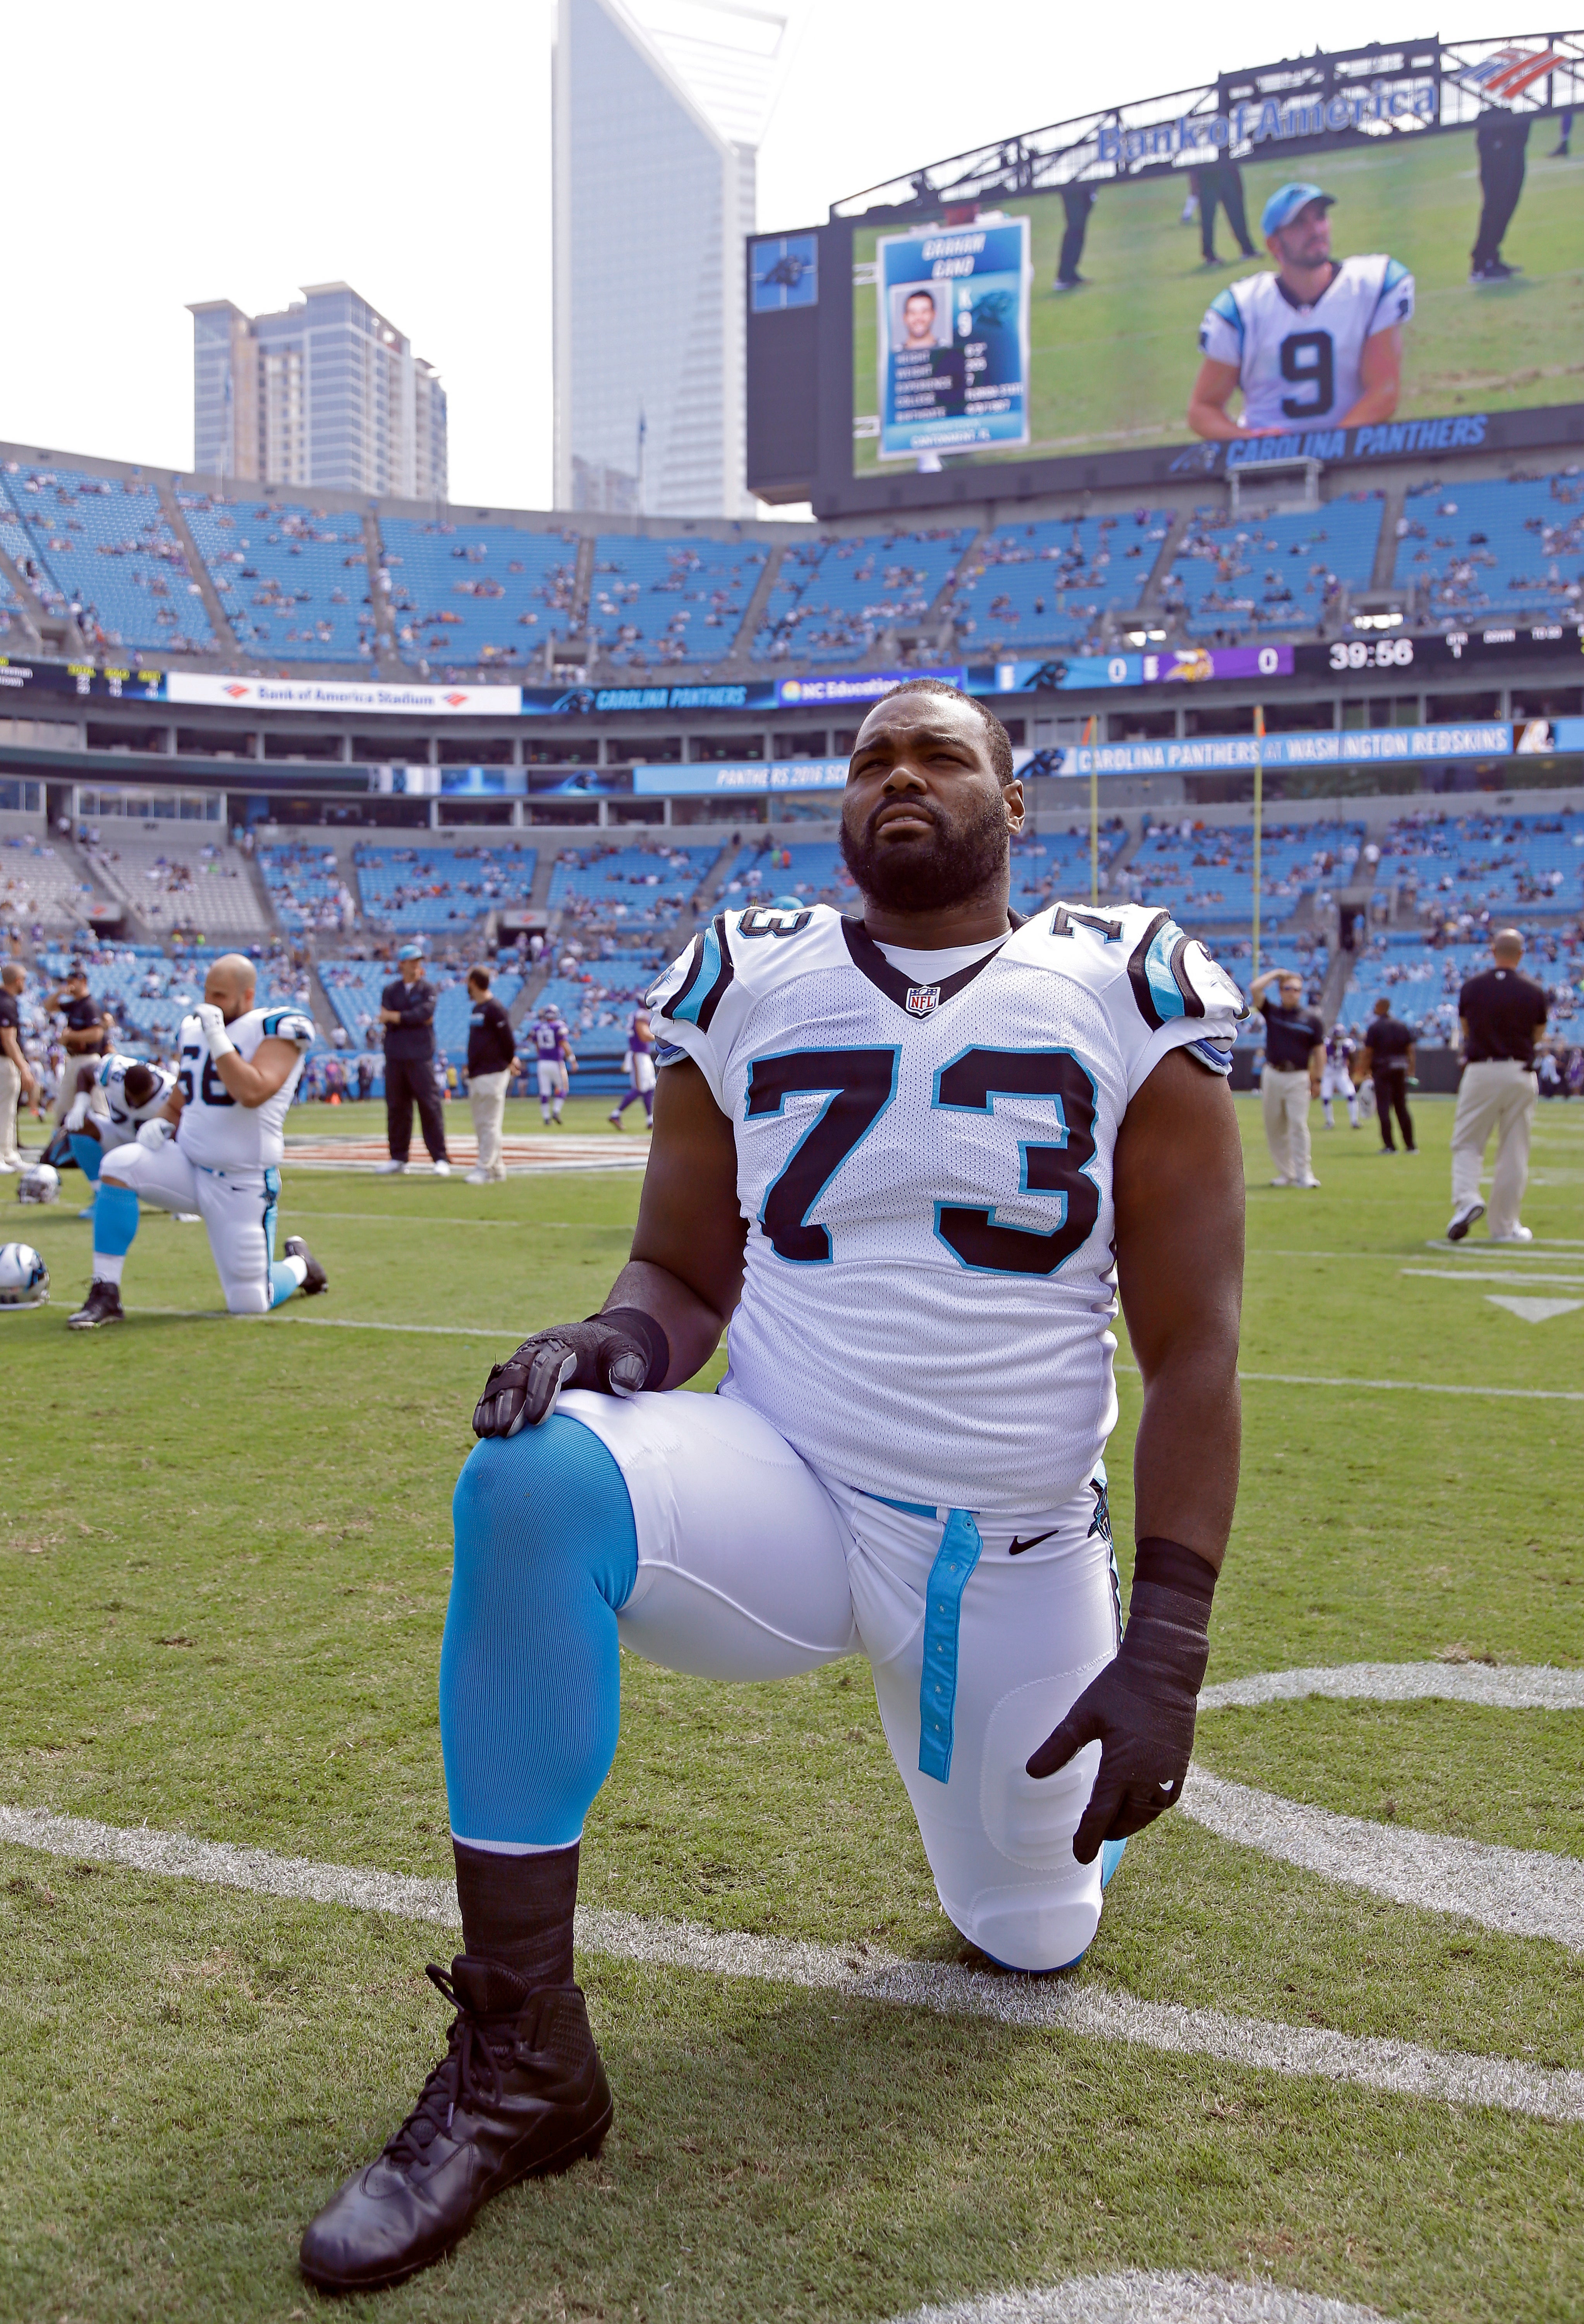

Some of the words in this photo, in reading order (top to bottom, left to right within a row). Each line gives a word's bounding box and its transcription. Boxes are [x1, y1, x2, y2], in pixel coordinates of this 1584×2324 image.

[1098, 115, 1200, 161] Bank
[1209, 98, 1250, 147] of
[1253, 80, 1438, 142] America
[922, 233, 986, 260] GRAHAM
[959, 288, 972, 309] K
[958, 311, 972, 337] 9
[1280, 330, 1334, 419] 9
[1226, 430, 1347, 465] CAROLINA
[1354, 414, 1489, 456] PANTHERS
[1258, 647, 1279, 674] 0
[1330, 638, 1414, 670] 39:56
[1108, 658, 1127, 683] 0
[259, 685, 292, 700] Bank
[299, 687, 312, 701] of
[316, 688, 372, 703] America
[378, 689, 433, 704] Stadium
[596, 688, 668, 710] CAROLINA
[669, 686, 747, 708] PANTHERS
[802, 682, 825, 700] NC
[1079, 746, 1164, 771] CAROLINA
[1168, 741, 1260, 767] PANTHERS
[1411, 728, 1508, 755] REDSKINS
[717, 768, 789, 786] PANTHERS
[911, 997, 933, 1009] NFL
[744, 1044, 1101, 1277] 73
